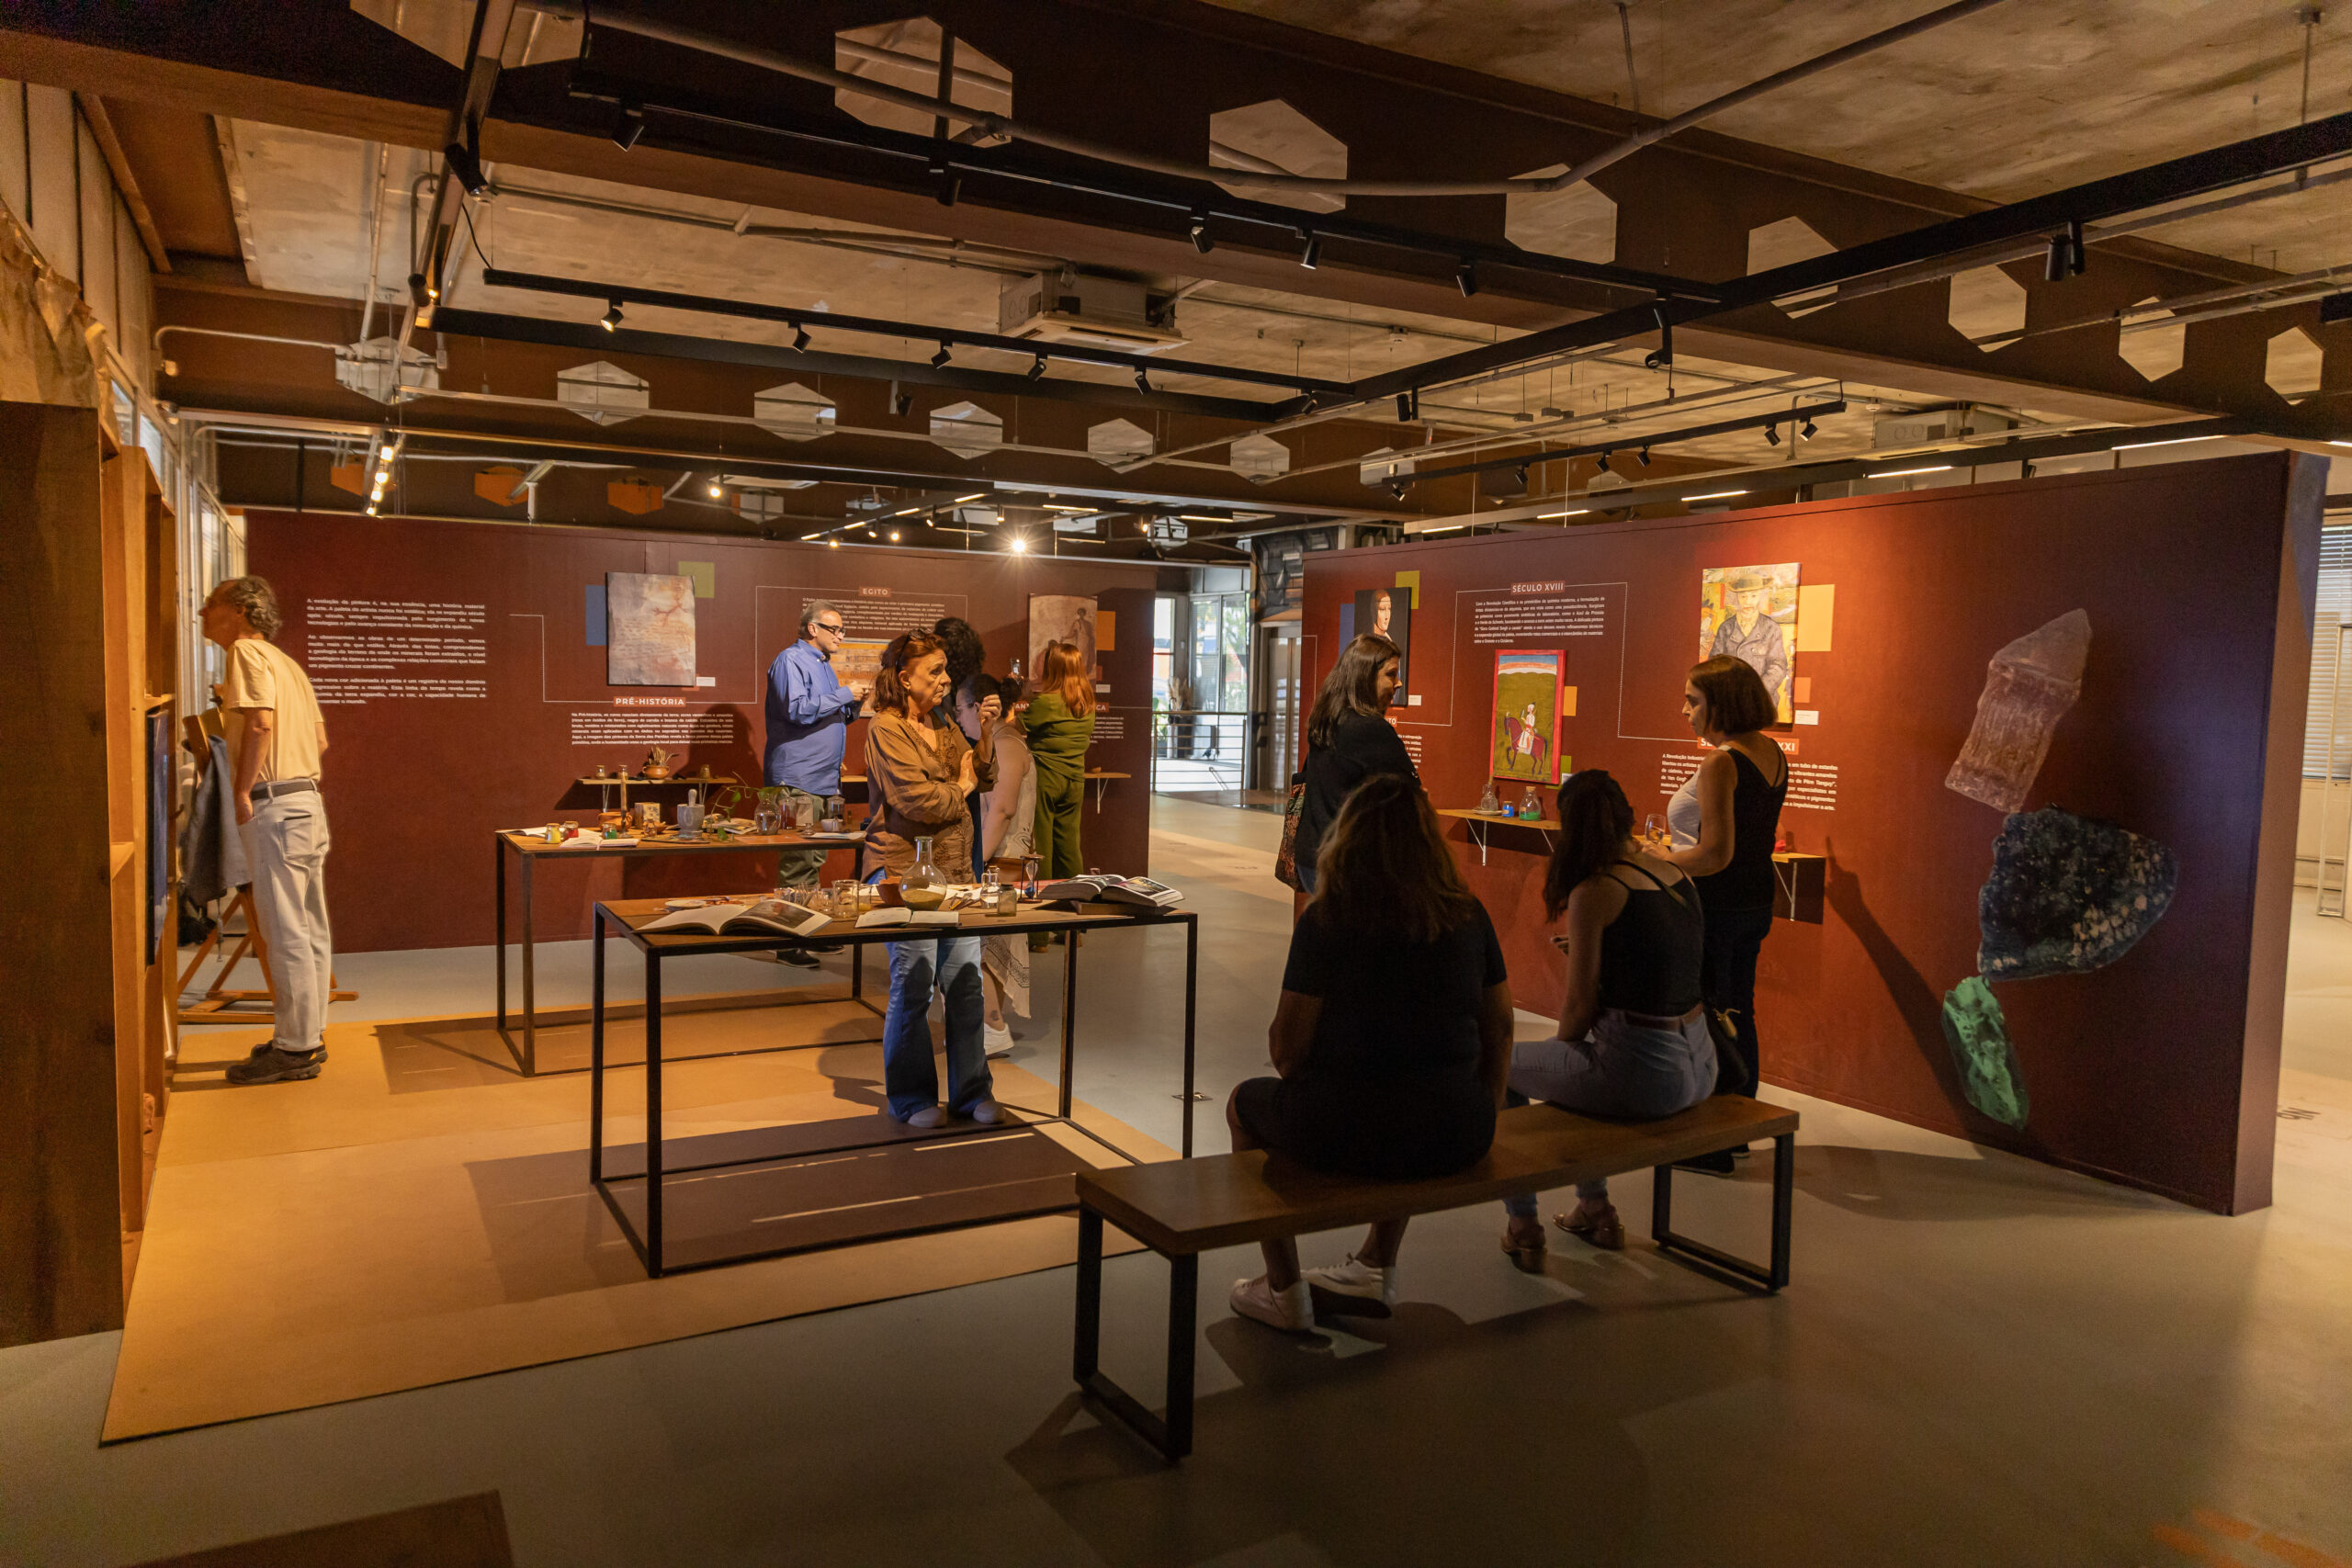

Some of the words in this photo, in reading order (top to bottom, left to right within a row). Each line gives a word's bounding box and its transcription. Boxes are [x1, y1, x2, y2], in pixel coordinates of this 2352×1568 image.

[1513, 583, 1542, 592] SÉCULO
[1545, 583, 1563, 591] XVIII
[616, 697, 684, 705] PRÉ-HISTÓRIA
